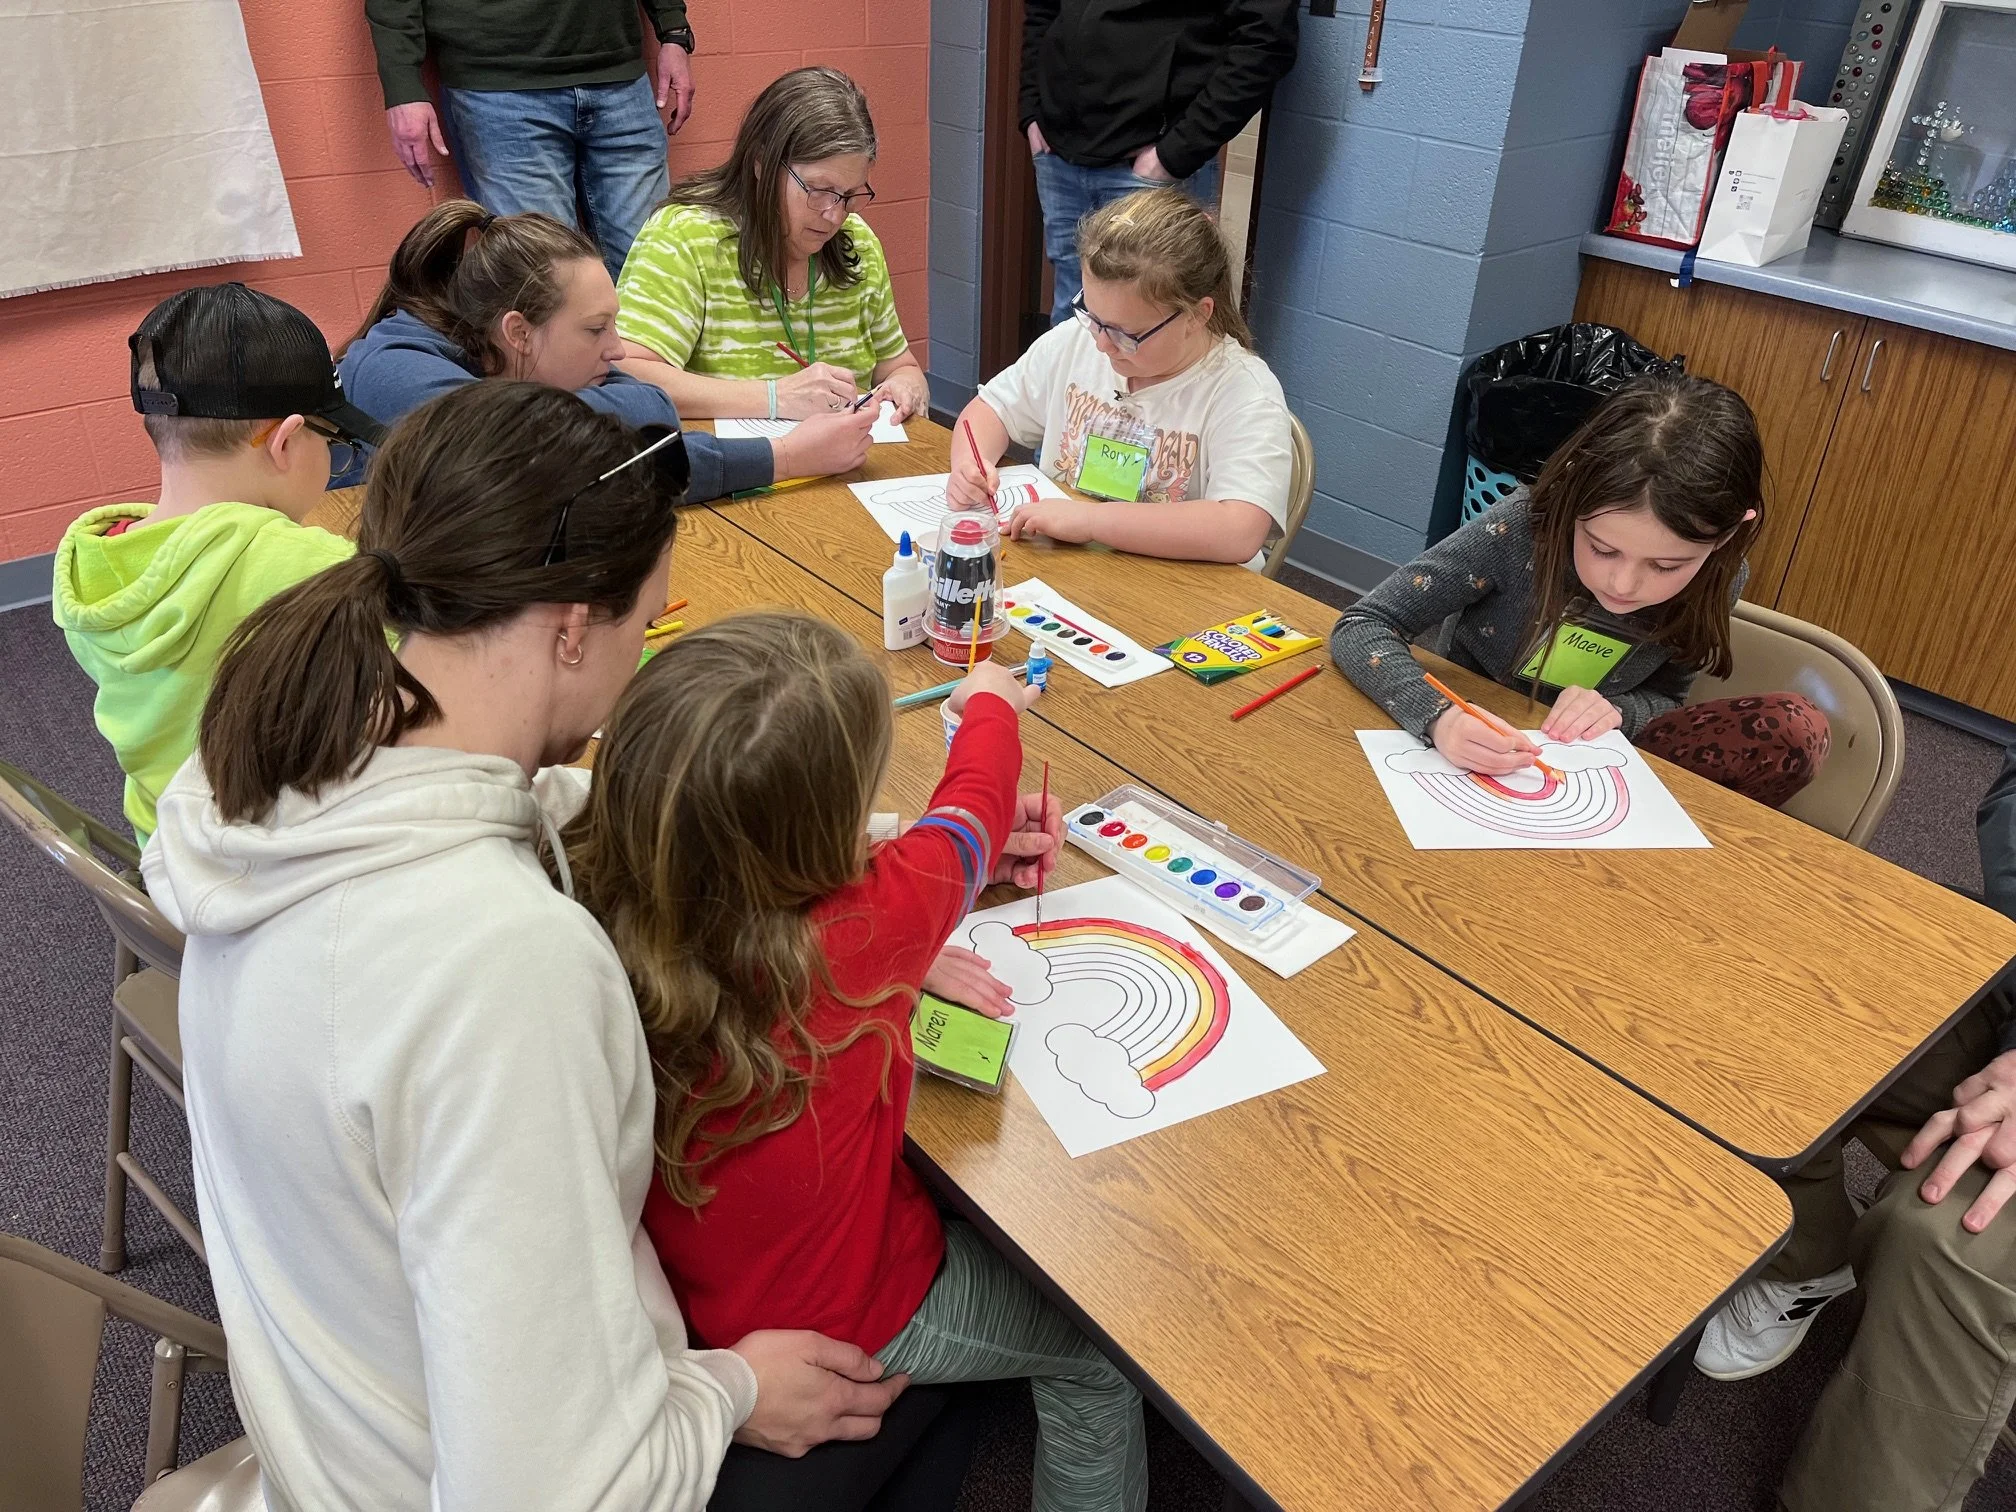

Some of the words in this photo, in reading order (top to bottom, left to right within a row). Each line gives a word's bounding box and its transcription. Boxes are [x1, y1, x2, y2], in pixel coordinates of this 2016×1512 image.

[1101, 444, 1131, 467] Rory
[1185, 653, 1203, 663] 12
[1195, 634, 1248, 662] PENCILS
[1204, 630, 1262, 659] COLORED
[1563, 632, 1614, 658] Maeve
[915, 1009, 950, 1052] Maren
